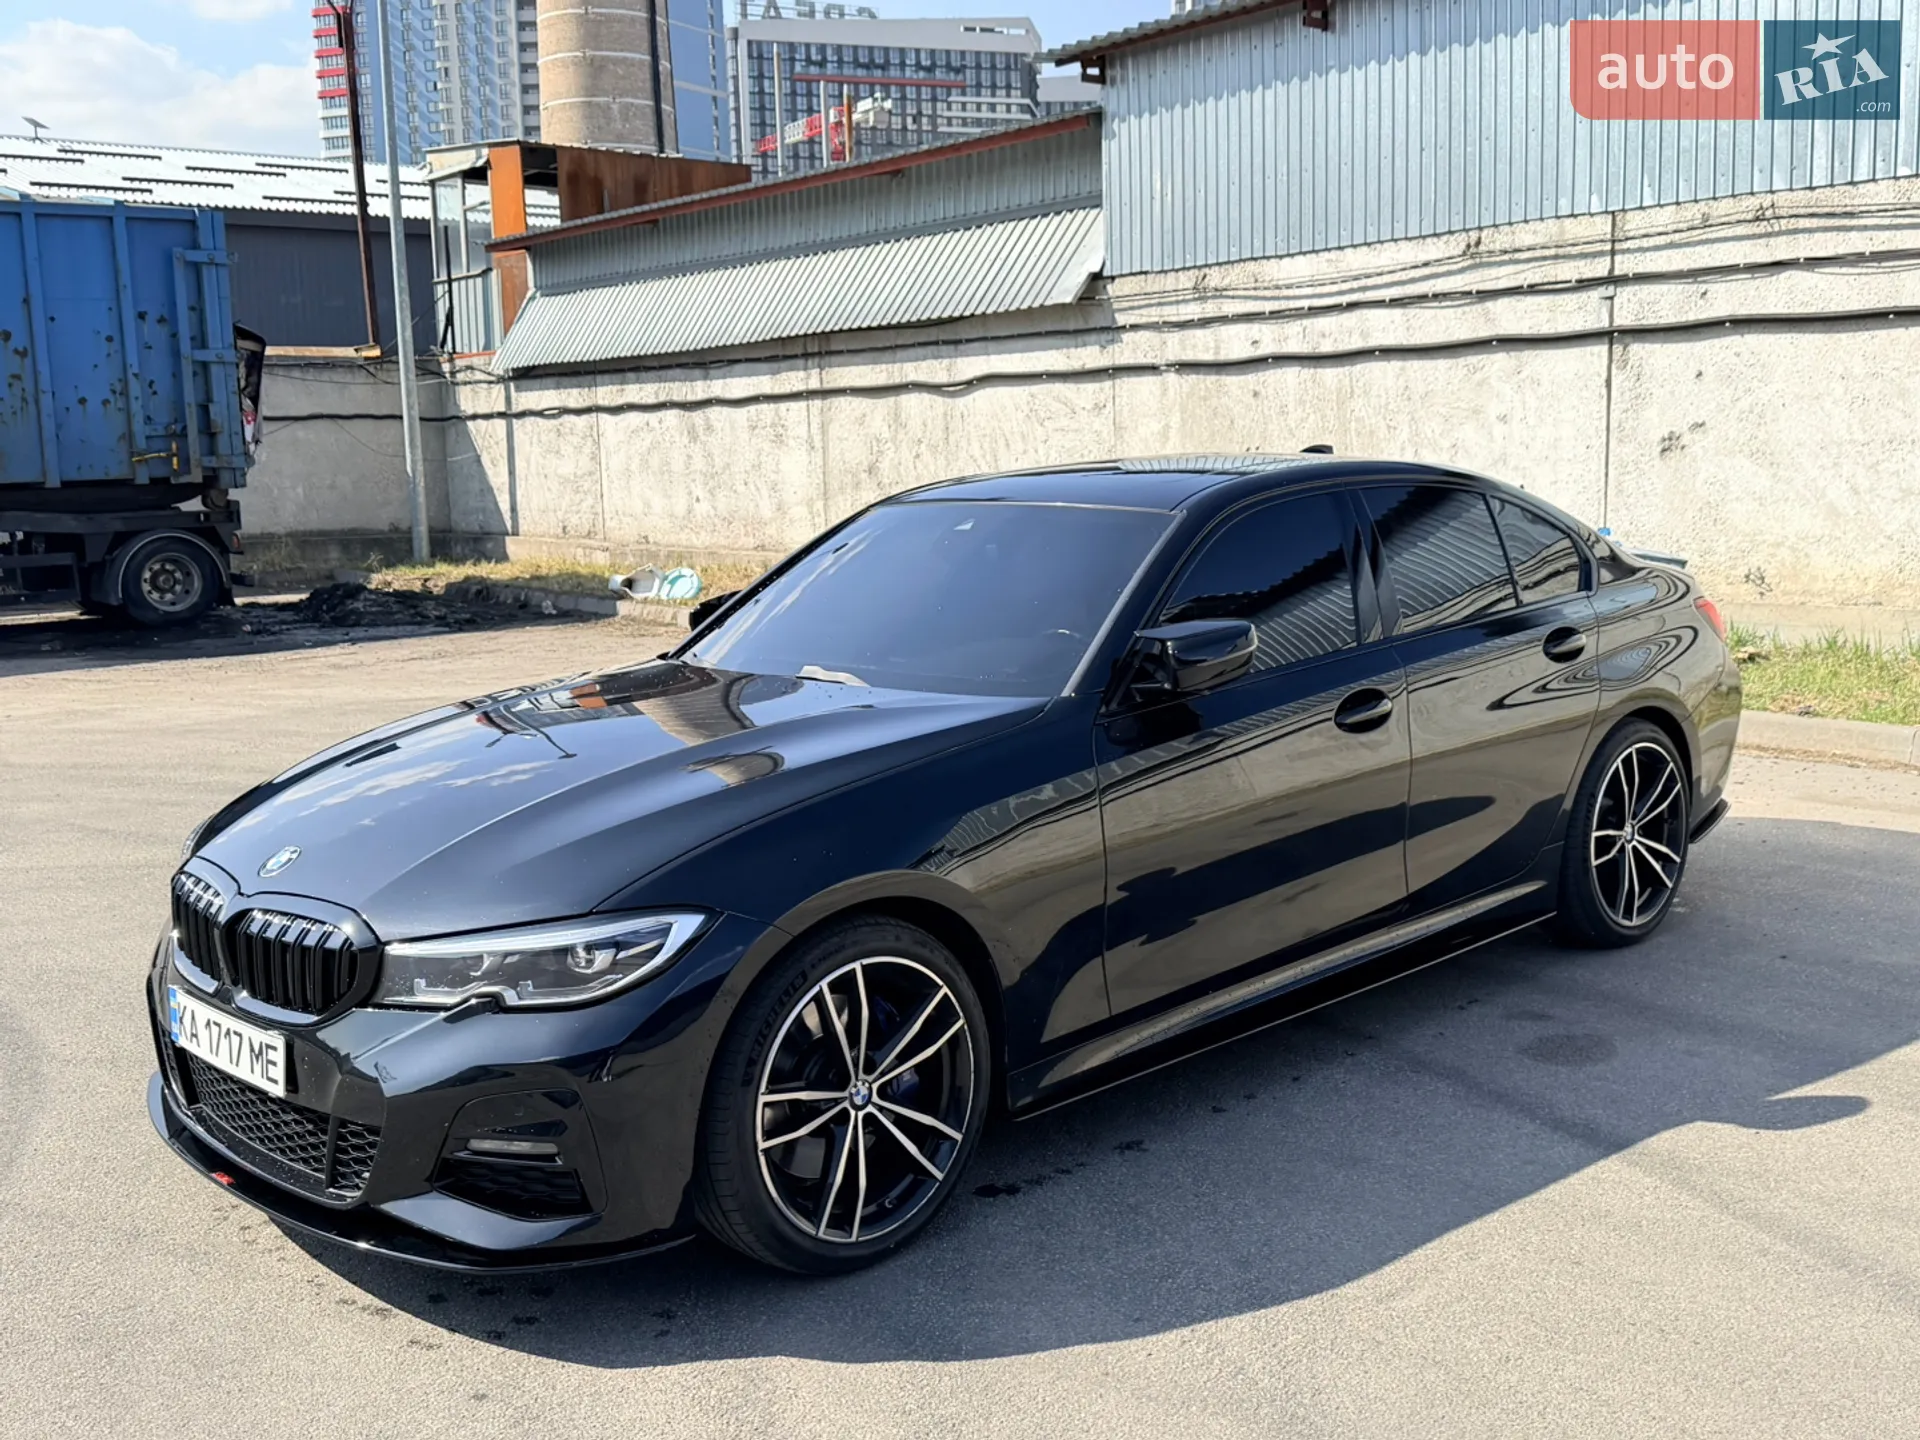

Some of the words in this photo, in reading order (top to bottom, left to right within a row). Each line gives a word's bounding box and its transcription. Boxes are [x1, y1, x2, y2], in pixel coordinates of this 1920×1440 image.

[178, 1002, 200, 1048] KA
[204, 1018, 243, 1068] 1717
[248, 1035, 279, 1087] ME
